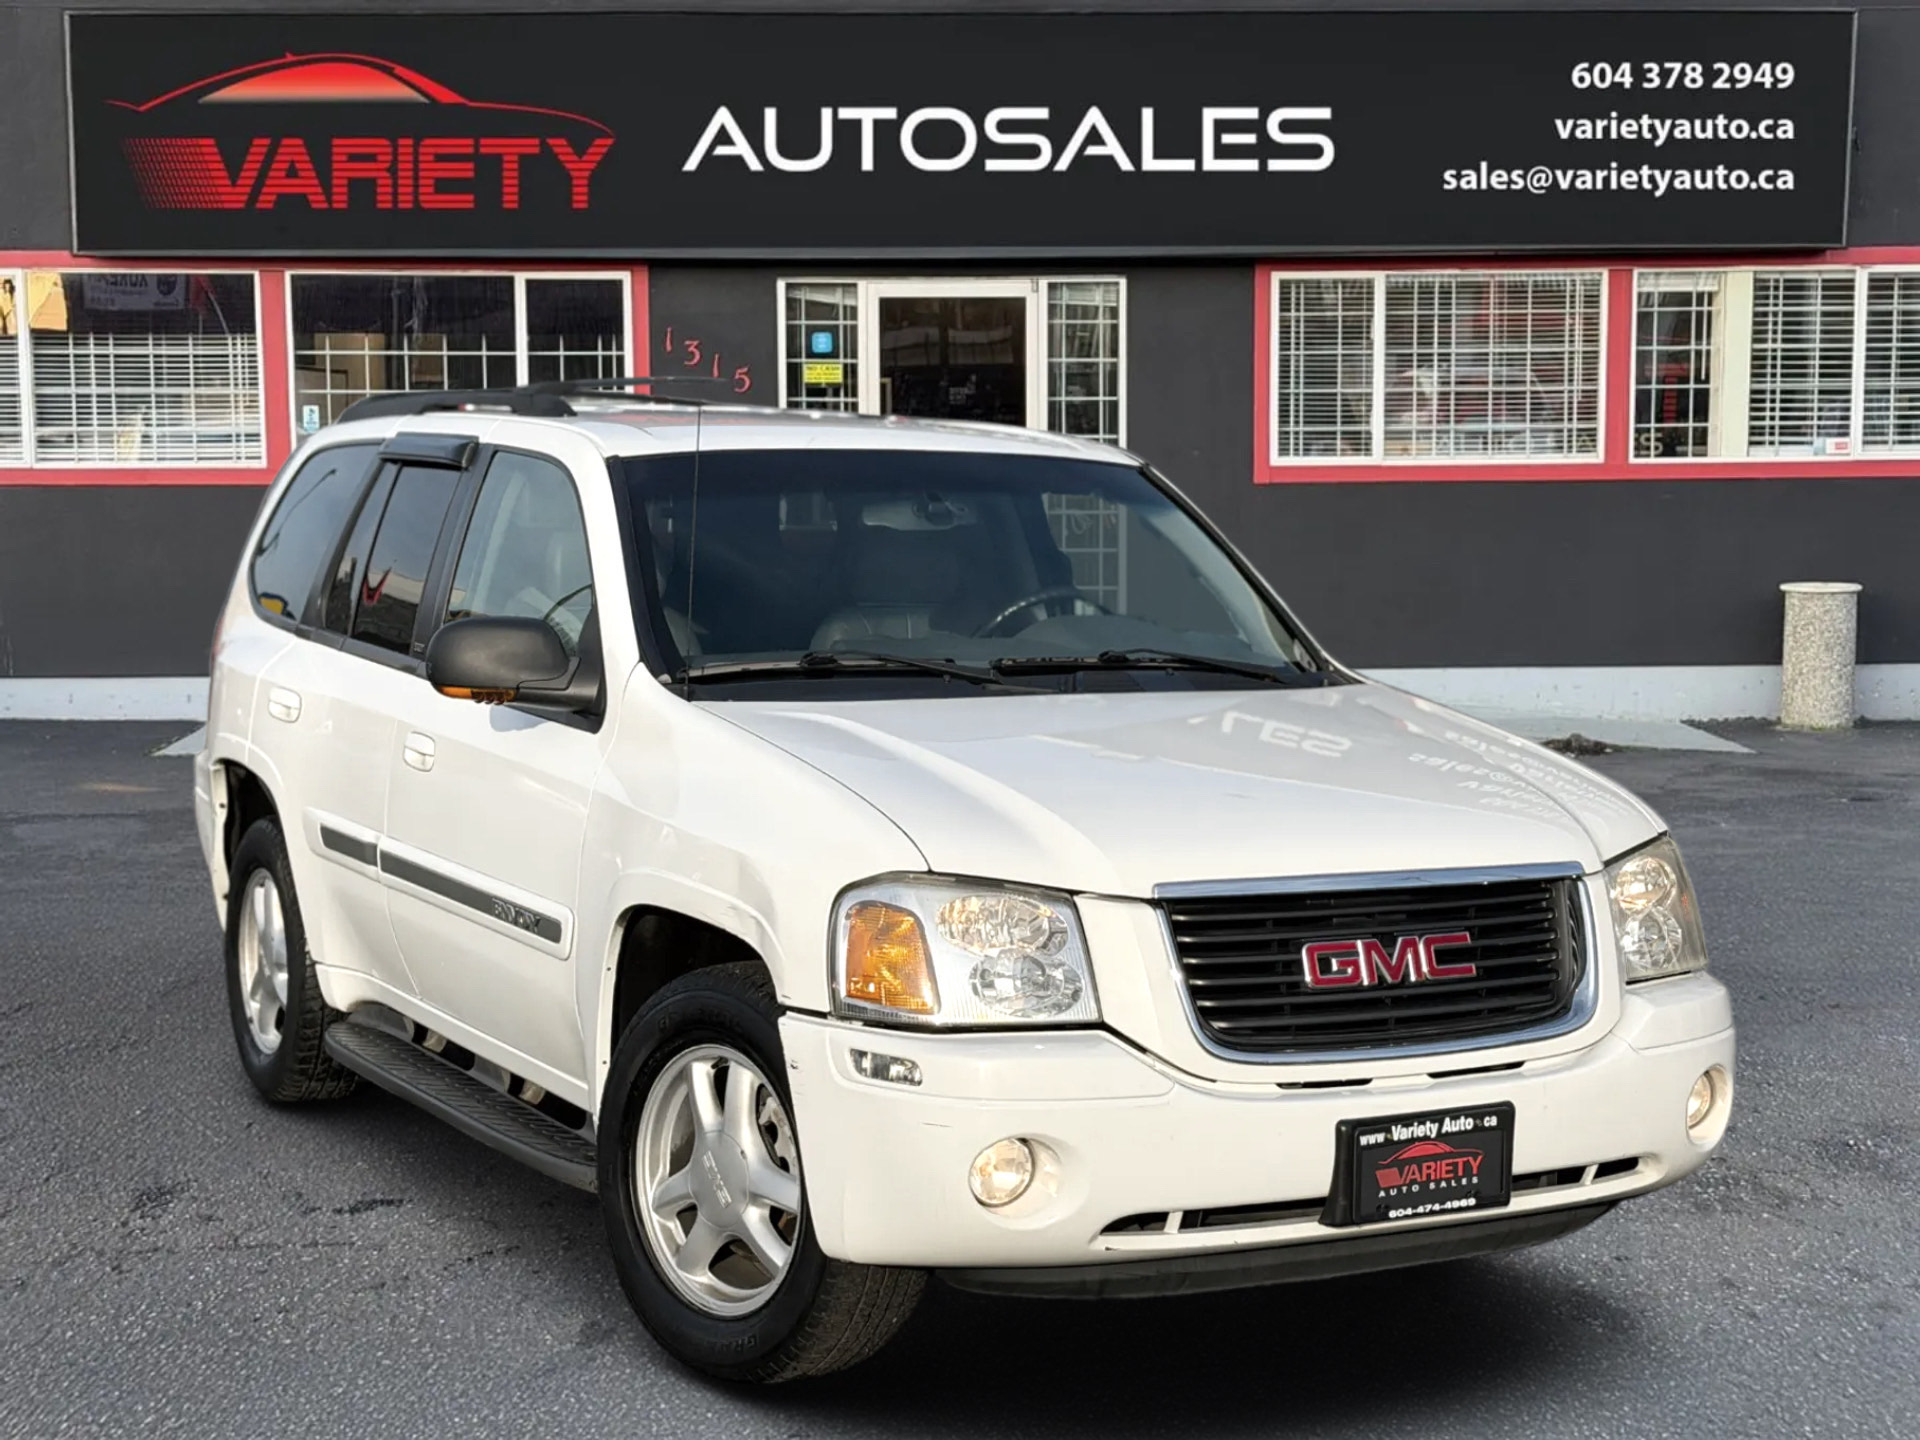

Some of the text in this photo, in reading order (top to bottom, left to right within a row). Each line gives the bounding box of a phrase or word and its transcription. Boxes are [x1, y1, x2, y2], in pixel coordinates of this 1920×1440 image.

[1571, 62, 1795, 89] 604 378 2949
[683, 106, 1335, 172] AUTOSALES
[1555, 112, 1795, 148] varietyauto.ca
[126, 137, 614, 210] VARIETY
[1443, 162, 1795, 197] sales@varietyauto.ca
[664, 327, 752, 393] 1315
[1302, 931, 1477, 989] GMC
[1359, 1115, 1498, 1147] www Variety Auto ca
[1375, 1155, 1484, 1189] VARIETY
[1378, 1176, 1479, 1198] AUTO SALES
[1388, 1197, 1476, 1219] 604-474-4969
